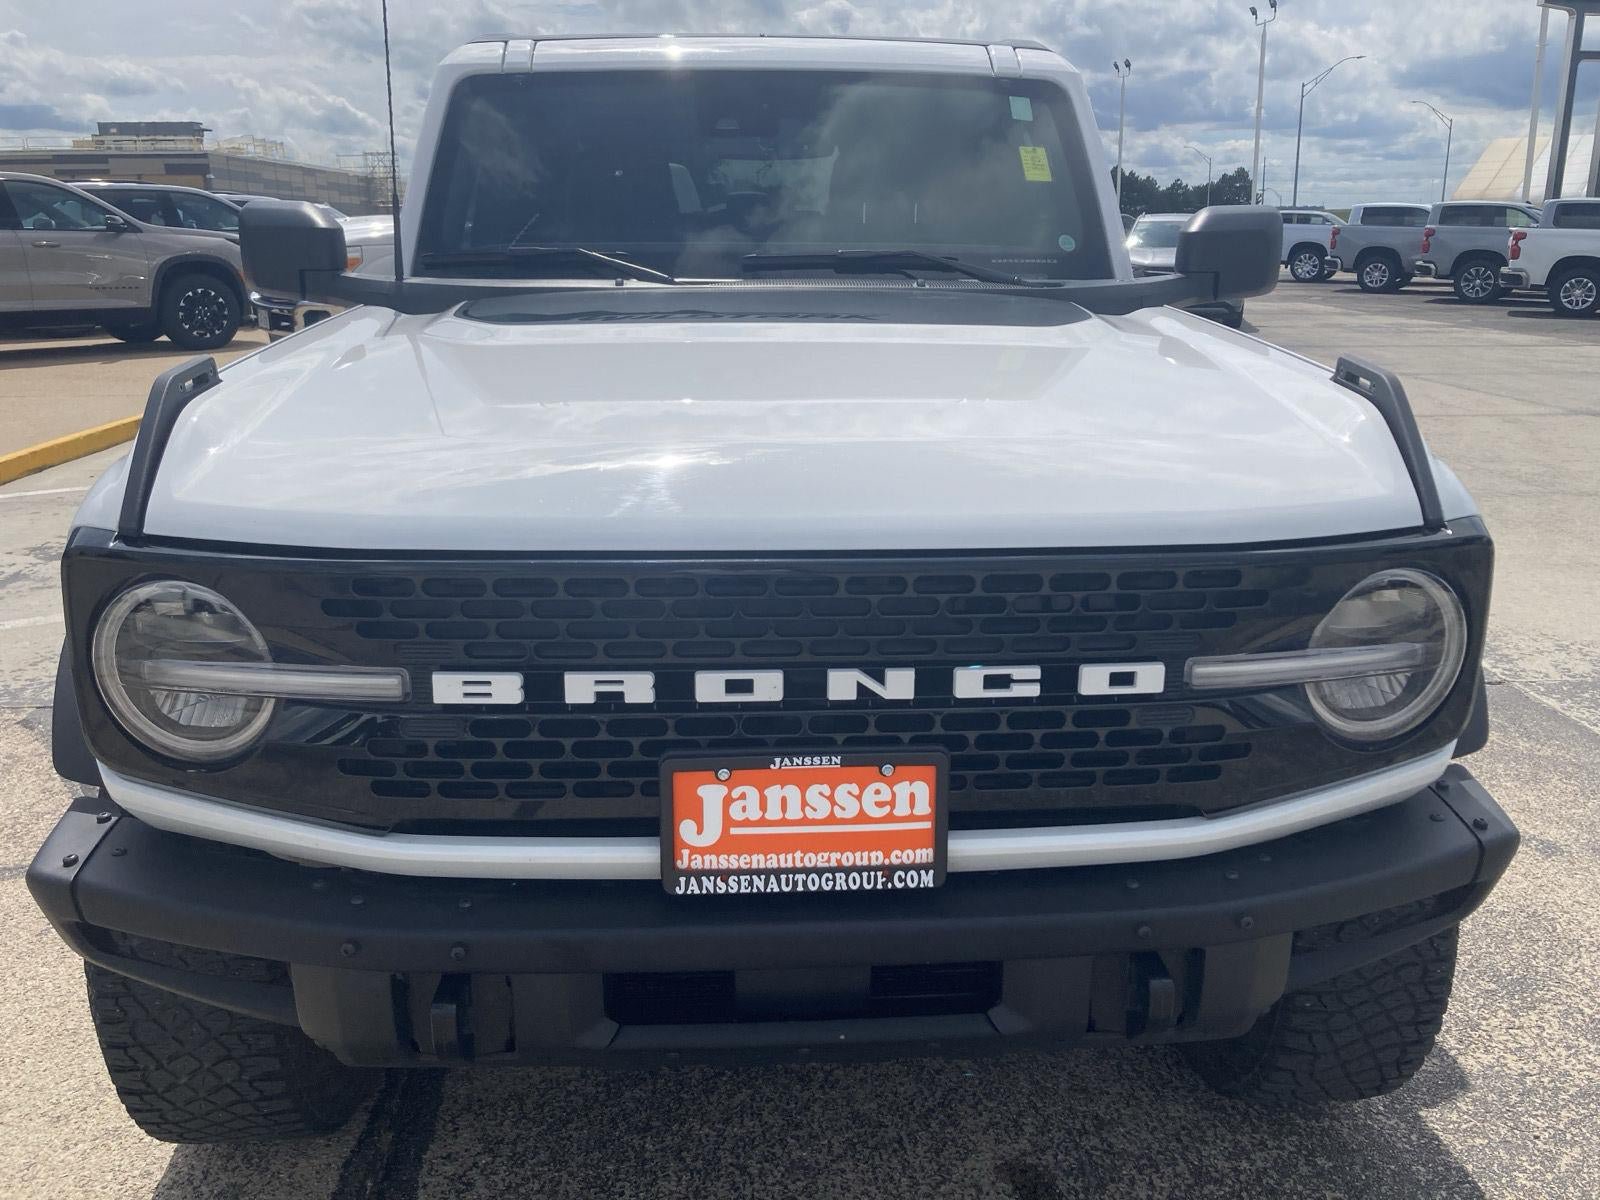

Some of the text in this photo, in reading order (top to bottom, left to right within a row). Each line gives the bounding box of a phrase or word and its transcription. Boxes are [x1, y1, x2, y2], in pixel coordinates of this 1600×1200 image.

[432, 661, 1166, 705] BRONCO
[769, 756, 842, 769] JANSSEN
[679, 780, 932, 847] Janssen
